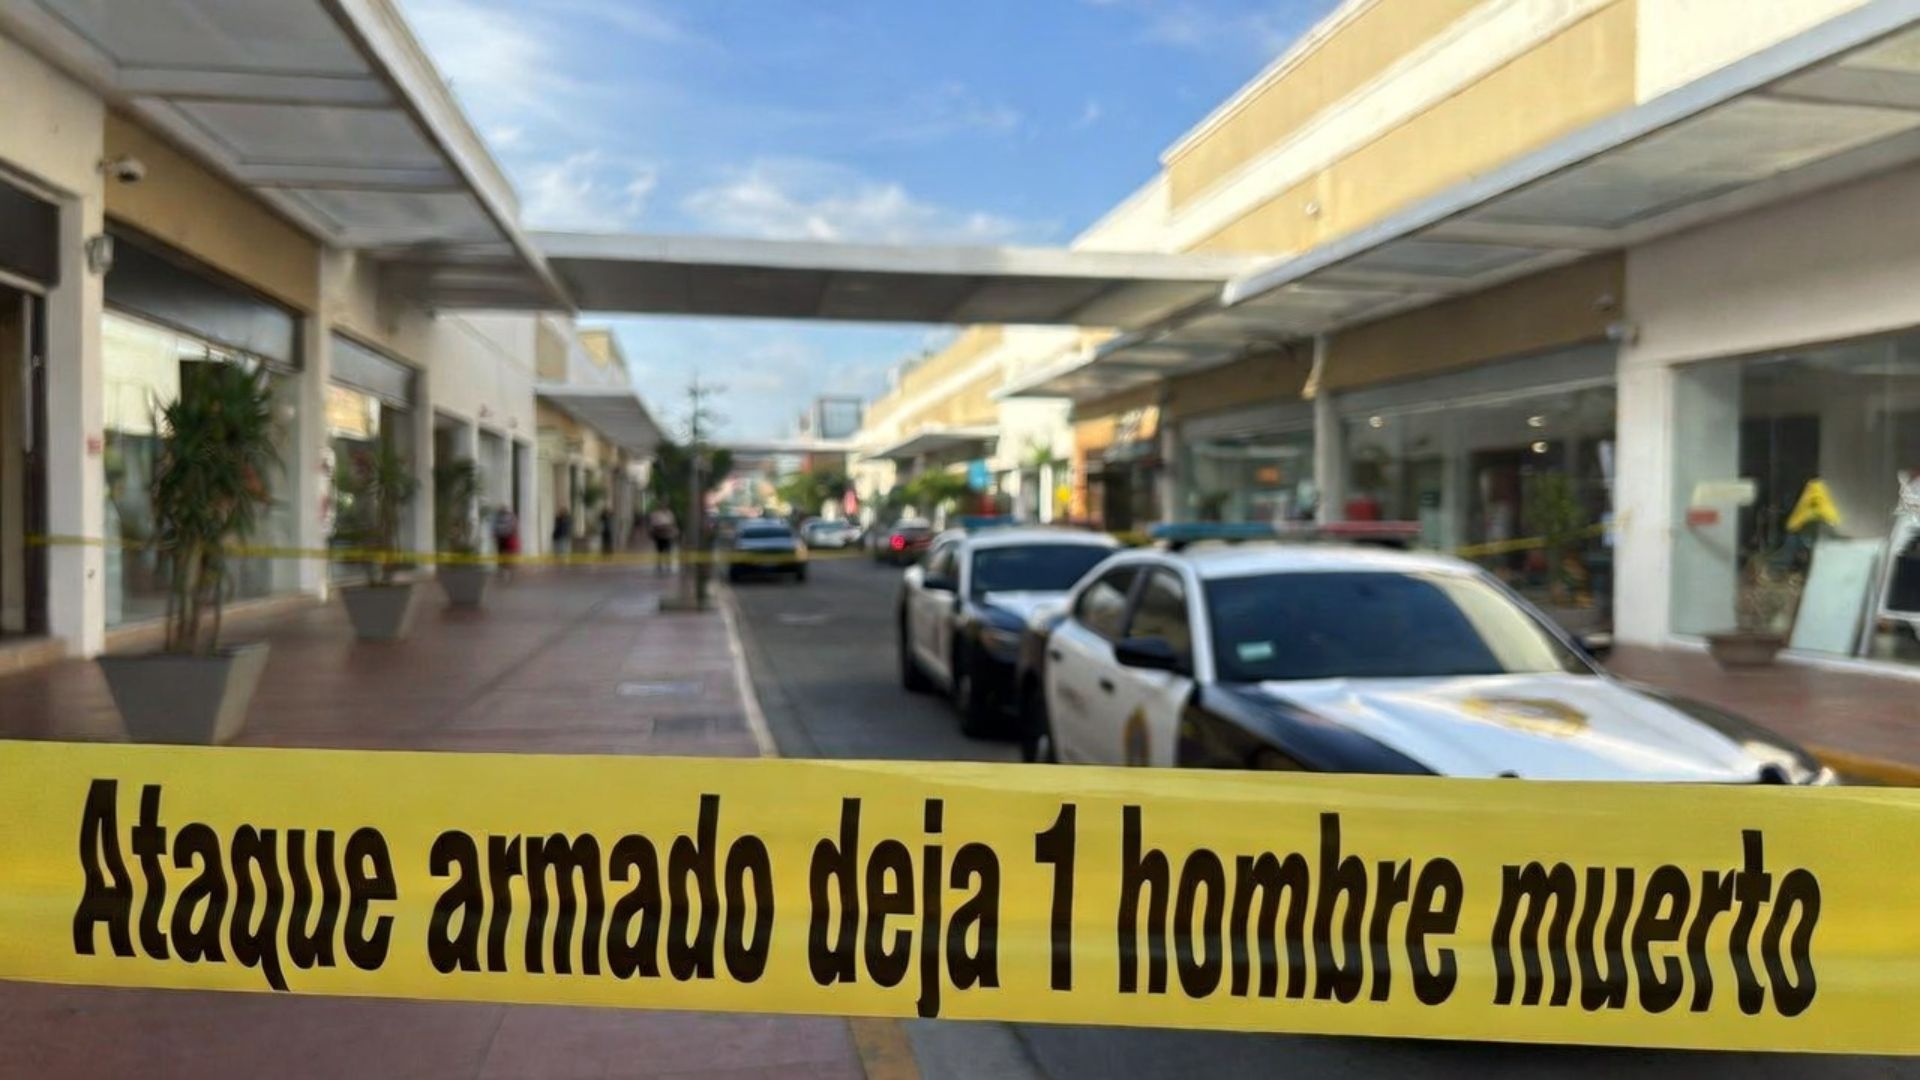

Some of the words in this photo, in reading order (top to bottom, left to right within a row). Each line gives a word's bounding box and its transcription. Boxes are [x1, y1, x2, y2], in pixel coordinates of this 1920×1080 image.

[73, 778, 398, 992] Ataque
[427, 793, 775, 984] armado
[808, 797, 1000, 1020] deja
[1035, 803, 1076, 991] 1
[1117, 805, 1464, 1006] hombre
[1491, 829, 1821, 1018] muerto
